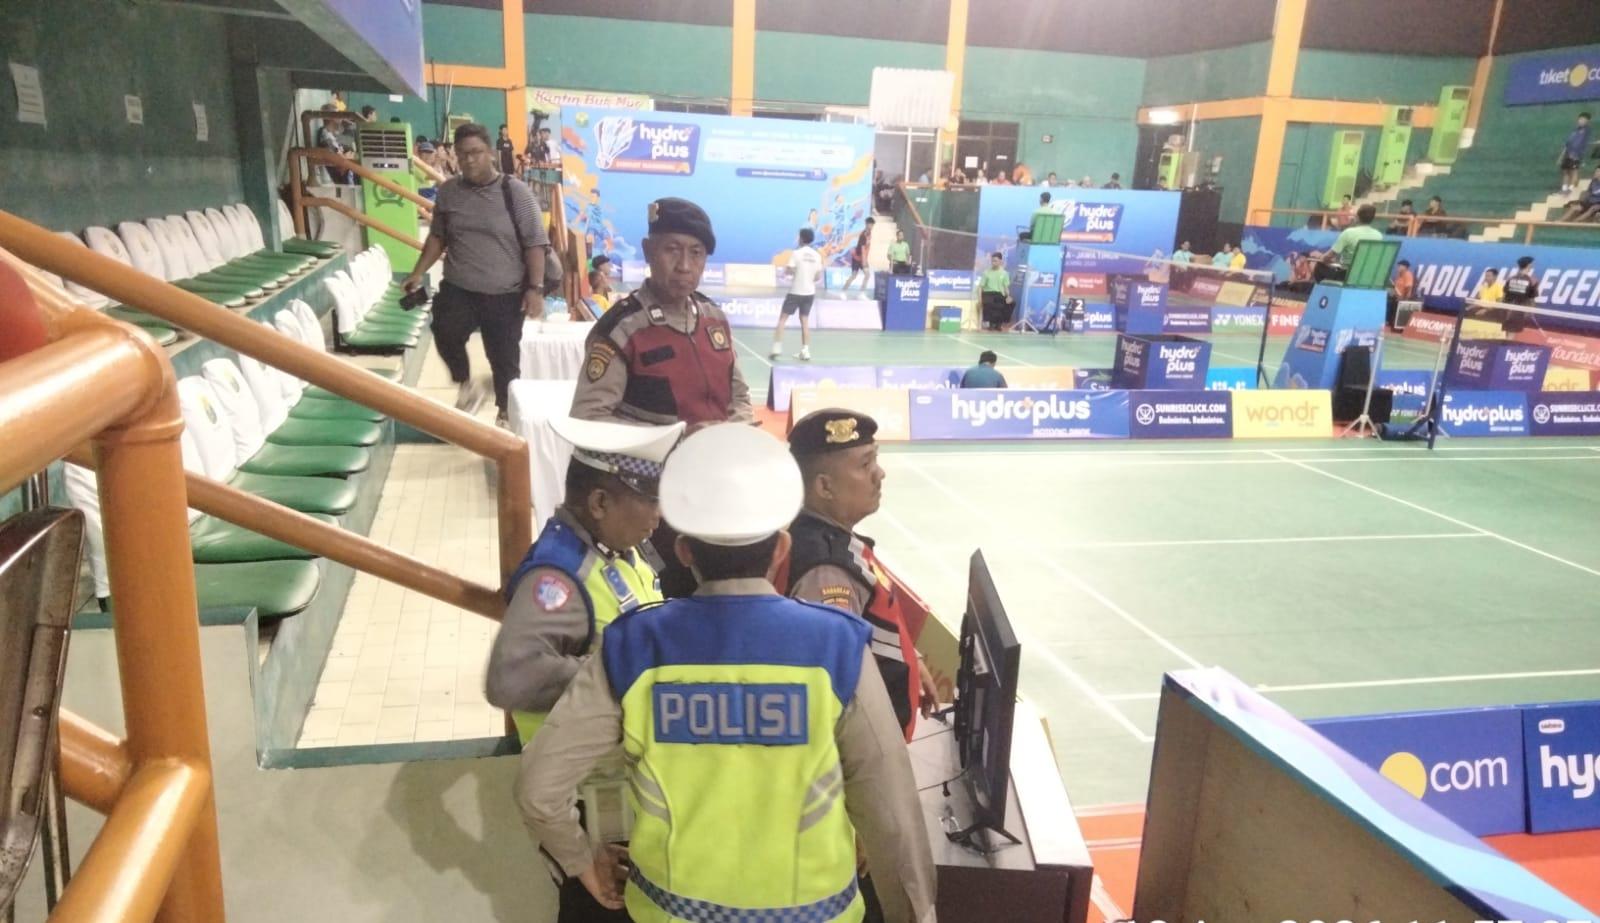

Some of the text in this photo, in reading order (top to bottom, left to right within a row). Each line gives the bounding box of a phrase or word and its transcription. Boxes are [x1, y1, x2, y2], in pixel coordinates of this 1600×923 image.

[1539, 68, 1570, 85] tiket
[535, 91, 580, 106] Kantin
[640, 123, 690, 142] hydro
[652, 142, 689, 160] plus
[1079, 203, 1117, 220] hydro
[1086, 216, 1115, 232] plus
[901, 288, 920, 301] plus
[1075, 299, 1084, 311] 2
[1232, 314, 1265, 327] YONEX
[1160, 345, 1203, 362] hydro
[1457, 342, 1488, 361] hydro
[1504, 349, 1541, 365] hydro
[1165, 359, 1195, 374] plus
[1460, 357, 1483, 371] plus
[1509, 361, 1536, 375] plus
[951, 394, 1091, 427] hydroplus
[1155, 403, 1227, 413] SUNRISECLICK.COM
[1247, 401, 1319, 422] wondr
[1442, 405, 1524, 426] hydroplus
[660, 692, 799, 737] POLISI
[1430, 755, 1508, 793] com
